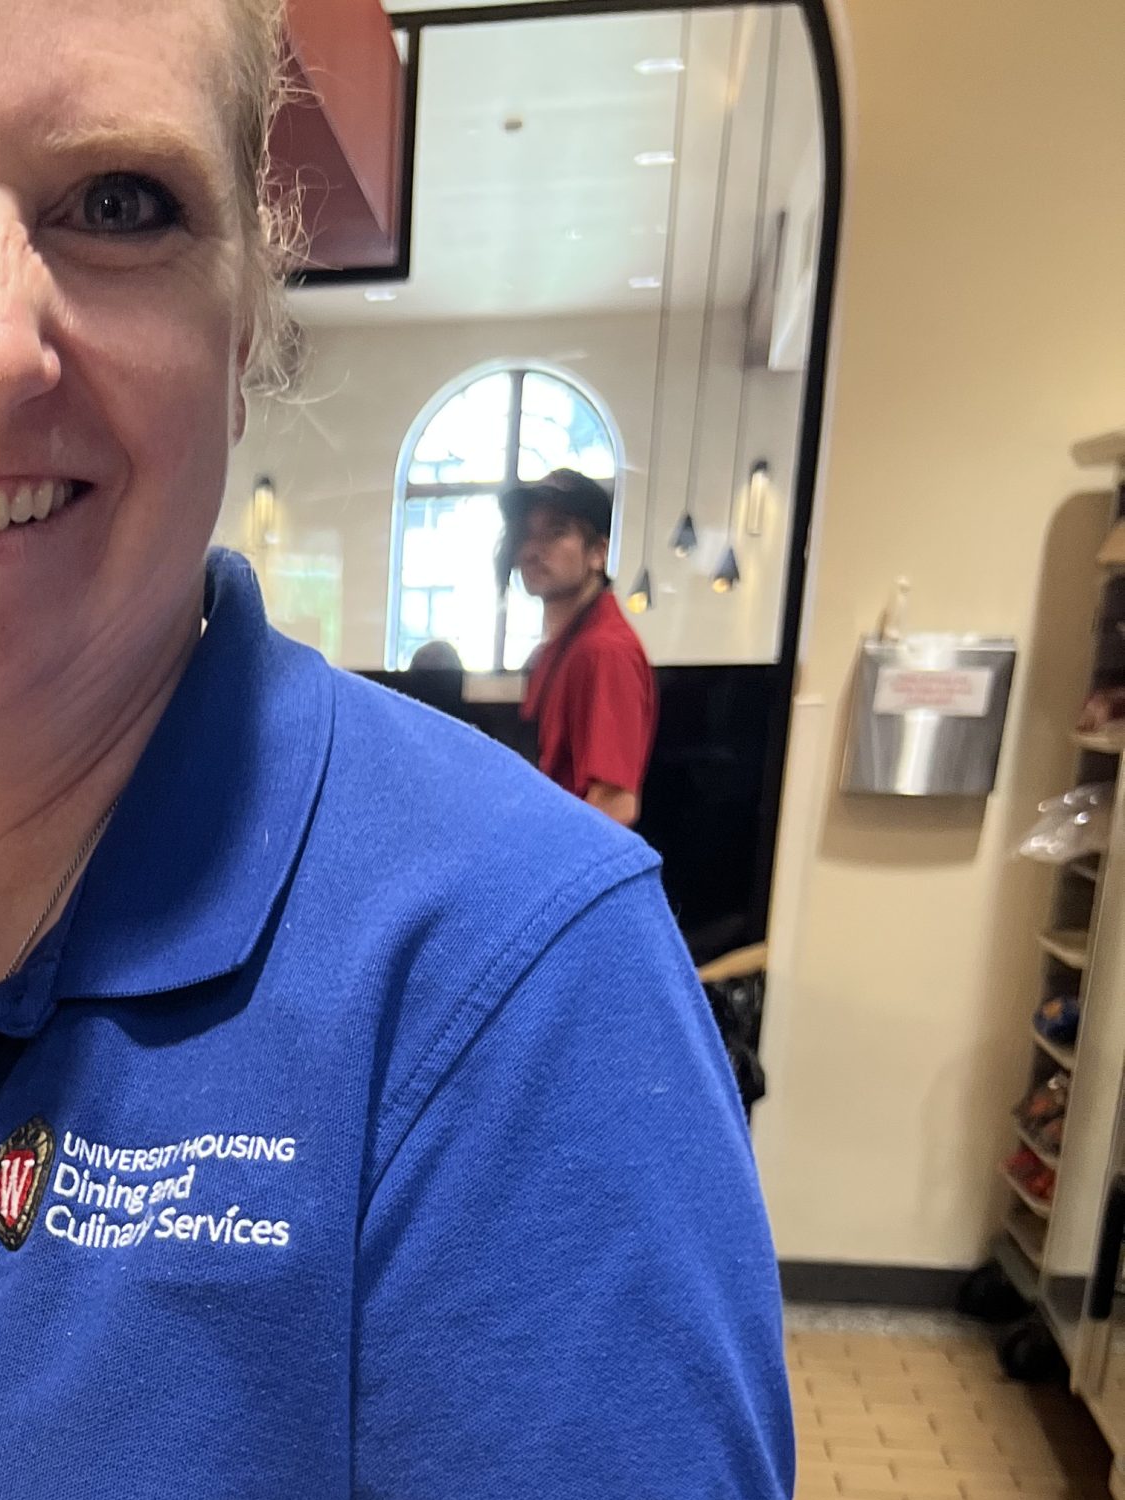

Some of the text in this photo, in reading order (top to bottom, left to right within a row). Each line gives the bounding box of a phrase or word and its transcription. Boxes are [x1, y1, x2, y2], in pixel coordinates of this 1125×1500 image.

[182, 1134, 295, 1161] HOUSING
[0, 1157, 35, 1220] W
[53, 1162, 195, 1215] Dining and
[154, 1205, 290, 1246] Services
